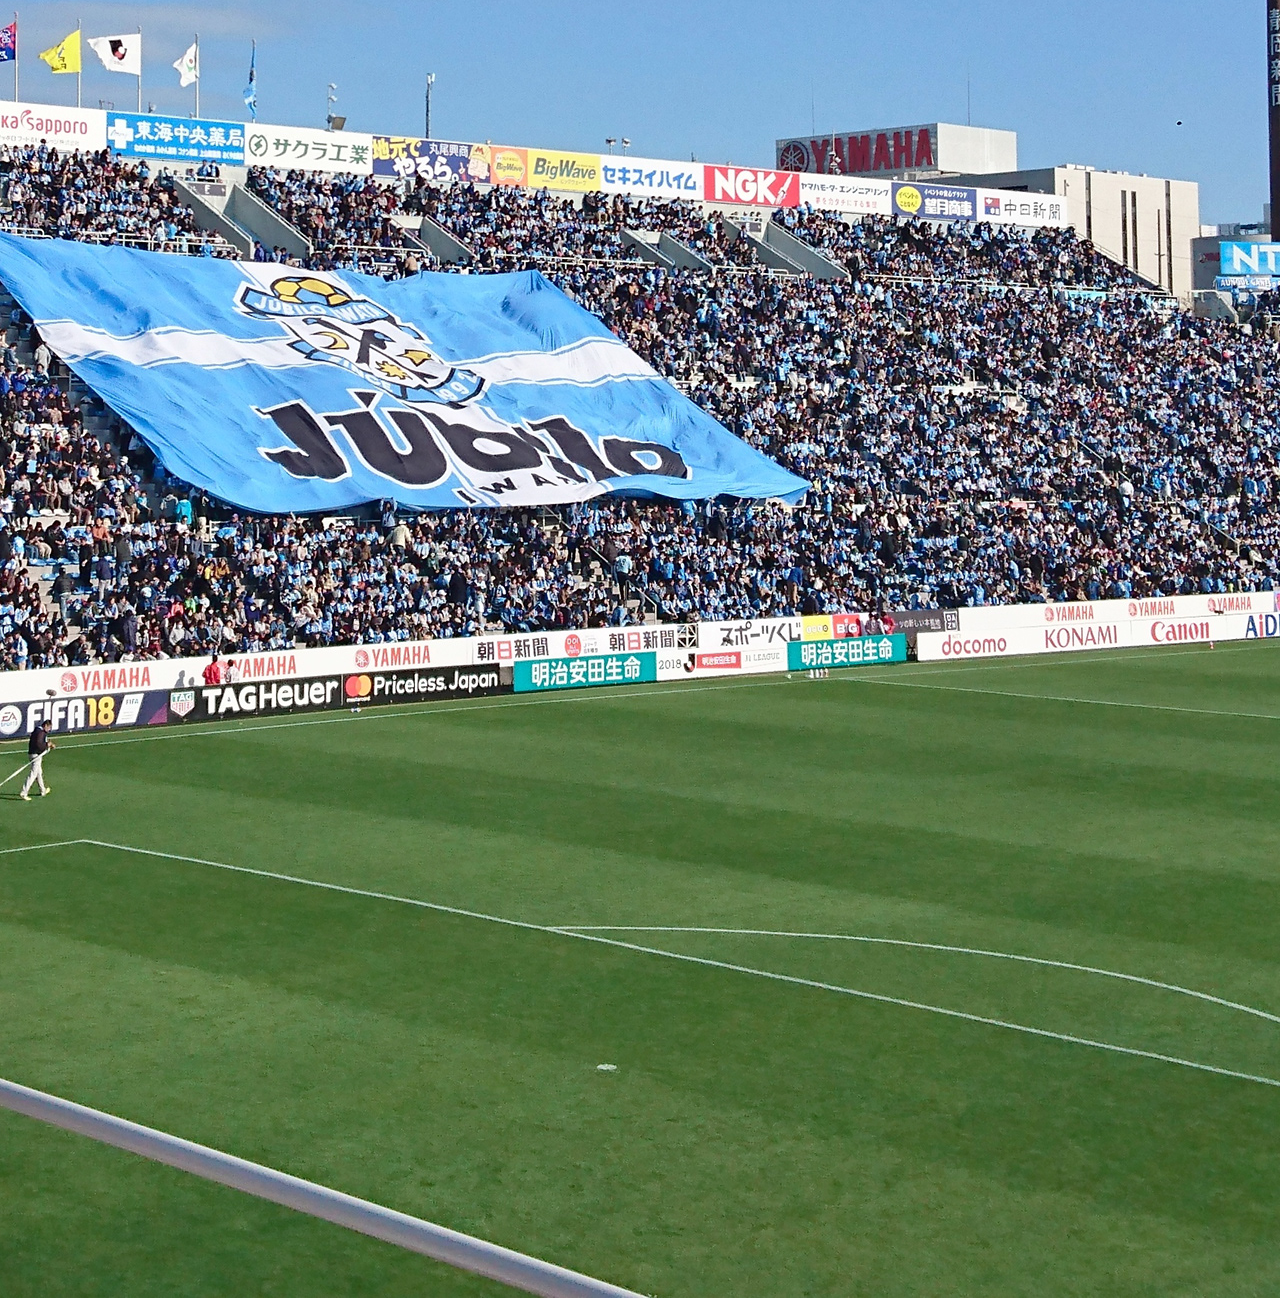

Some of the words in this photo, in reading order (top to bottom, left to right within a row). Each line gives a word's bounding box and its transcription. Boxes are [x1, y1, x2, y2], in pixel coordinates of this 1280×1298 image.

[134, 120, 244, 148] 東海中央薬局
[272, 137, 370, 165] サクラ工業
[372, 137, 422, 160] 地元で
[429, 142, 469, 158] 丸尾興商
[810, 128, 934, 174] YAMAHA
[392, 155, 459, 182] やるら。
[495, 162, 523, 172] BigWave
[533, 157, 597, 180] BigWave
[602, 164, 697, 191] セキスイハイム
[714, 167, 777, 204] NGK
[924, 198, 973, 216] 望月商事
[1003, 199, 1061, 221] 中日新聞
[1055, 604, 1094, 621] YAMAHA
[1138, 600, 1175, 616] YAMAHA
[1217, 596, 1252, 612] YAMAHA
[608, 628, 676, 651] 朝日新聞
[720, 619, 803, 647] スポーツくじ
[1044, 625, 1118, 649] KONAMI
[1150, 620, 1210, 642] Canon
[372, 645, 431, 668] YAMAHA
[477, 636, 550, 661] 朝日新聞
[800, 634, 894, 665] 明治安田生命
[941, 634, 1008, 656] docomo
[233, 655, 297, 679] YAMAHA
[530, 654, 643, 687] 明治安田生命
[658, 658, 682, 671] 2018
[80, 666, 151, 692] YAMAHA
[448, 668, 499, 694] Japan
[2, 711, 18, 722] EA
